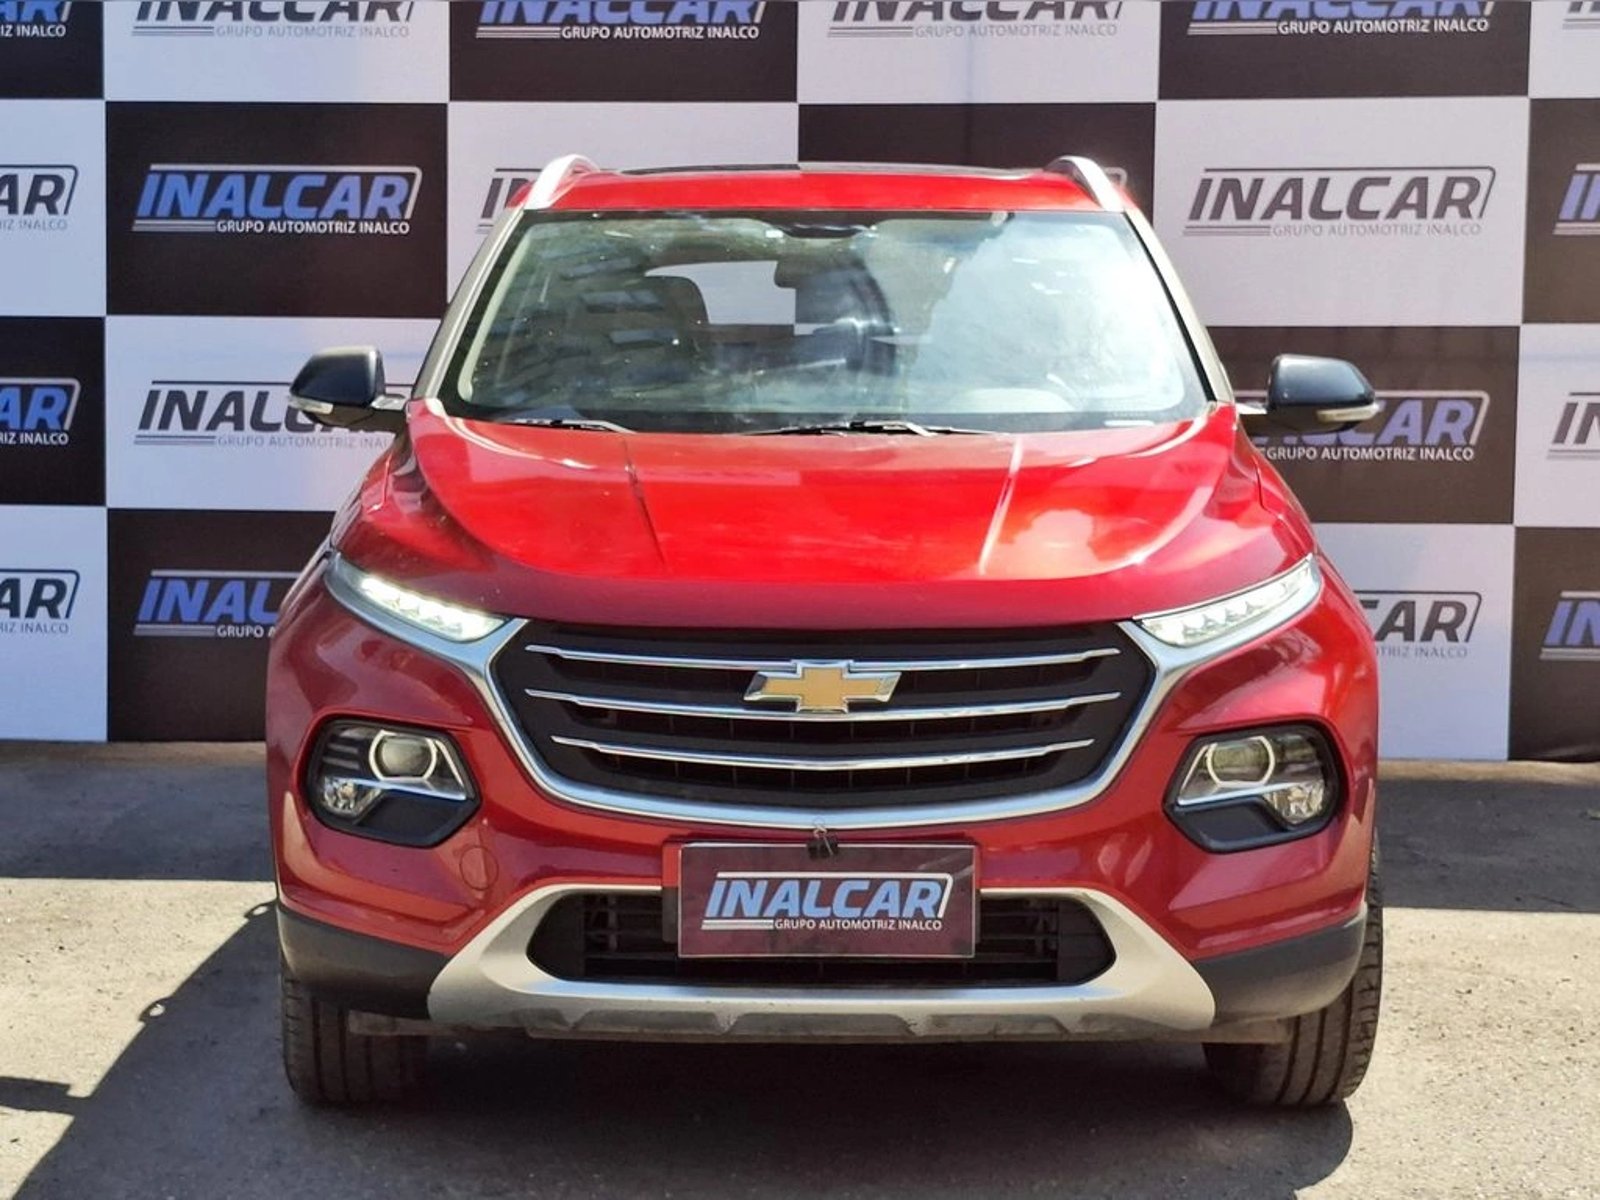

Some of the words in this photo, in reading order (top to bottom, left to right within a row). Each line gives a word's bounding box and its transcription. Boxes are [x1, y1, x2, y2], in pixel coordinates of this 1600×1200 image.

[16, 24, 67, 37] INALCO
[216, 26, 263, 38] GRUPO
[268, 26, 355, 38] AUTOMOTRIZ
[360, 26, 410, 38] INALCO
[562, 26, 610, 39] GRUPO
[615, 26, 705, 39] AUTOMOTRIZ
[707, 26, 760, 39] INALCO
[915, 26, 965, 38] GRUPO
[967, 26, 1061, 38] AUTOMOTRIZ
[1065, 25, 1118, 37] INALCO
[1277, 20, 1330, 35] GRUPO
[1332, 20, 1430, 35] AUTOMOTRIZ
[1433, 18, 1490, 33] INALCO
[136, 173, 409, 219] INALCAR
[1188, 175, 1483, 222] INALCAR
[216, 220, 265, 235] GRUPO
[267, 220, 357, 235] AUTOMOTRIZ
[359, 220, 411, 235] INALCO
[1272, 224, 1323, 237] GRUPO
[1328, 224, 1422, 237] AUTOMOTRIZ
[1426, 224, 1482, 237] INALCO
[138, 390, 384, 433] INAL
[20, 432, 70, 446] INALCO
[217, 436, 264, 448] GRUPO
[269, 436, 356, 448] AUTOMOTRIZ
[1266, 447, 1317, 461] GRUPO
[1321, 447, 1415, 461] AUTOMOTRIZ
[1419, 447, 1474, 461] INALCO
[137, 579, 279, 624] INAL
[217, 625, 265, 638] GRUPO
[704, 879, 943, 919] INALCAR
[774, 918, 816, 930] GRUPO
[818, 918, 896, 930] AUTOMOTRIZ
[898, 918, 943, 930] INALCO
